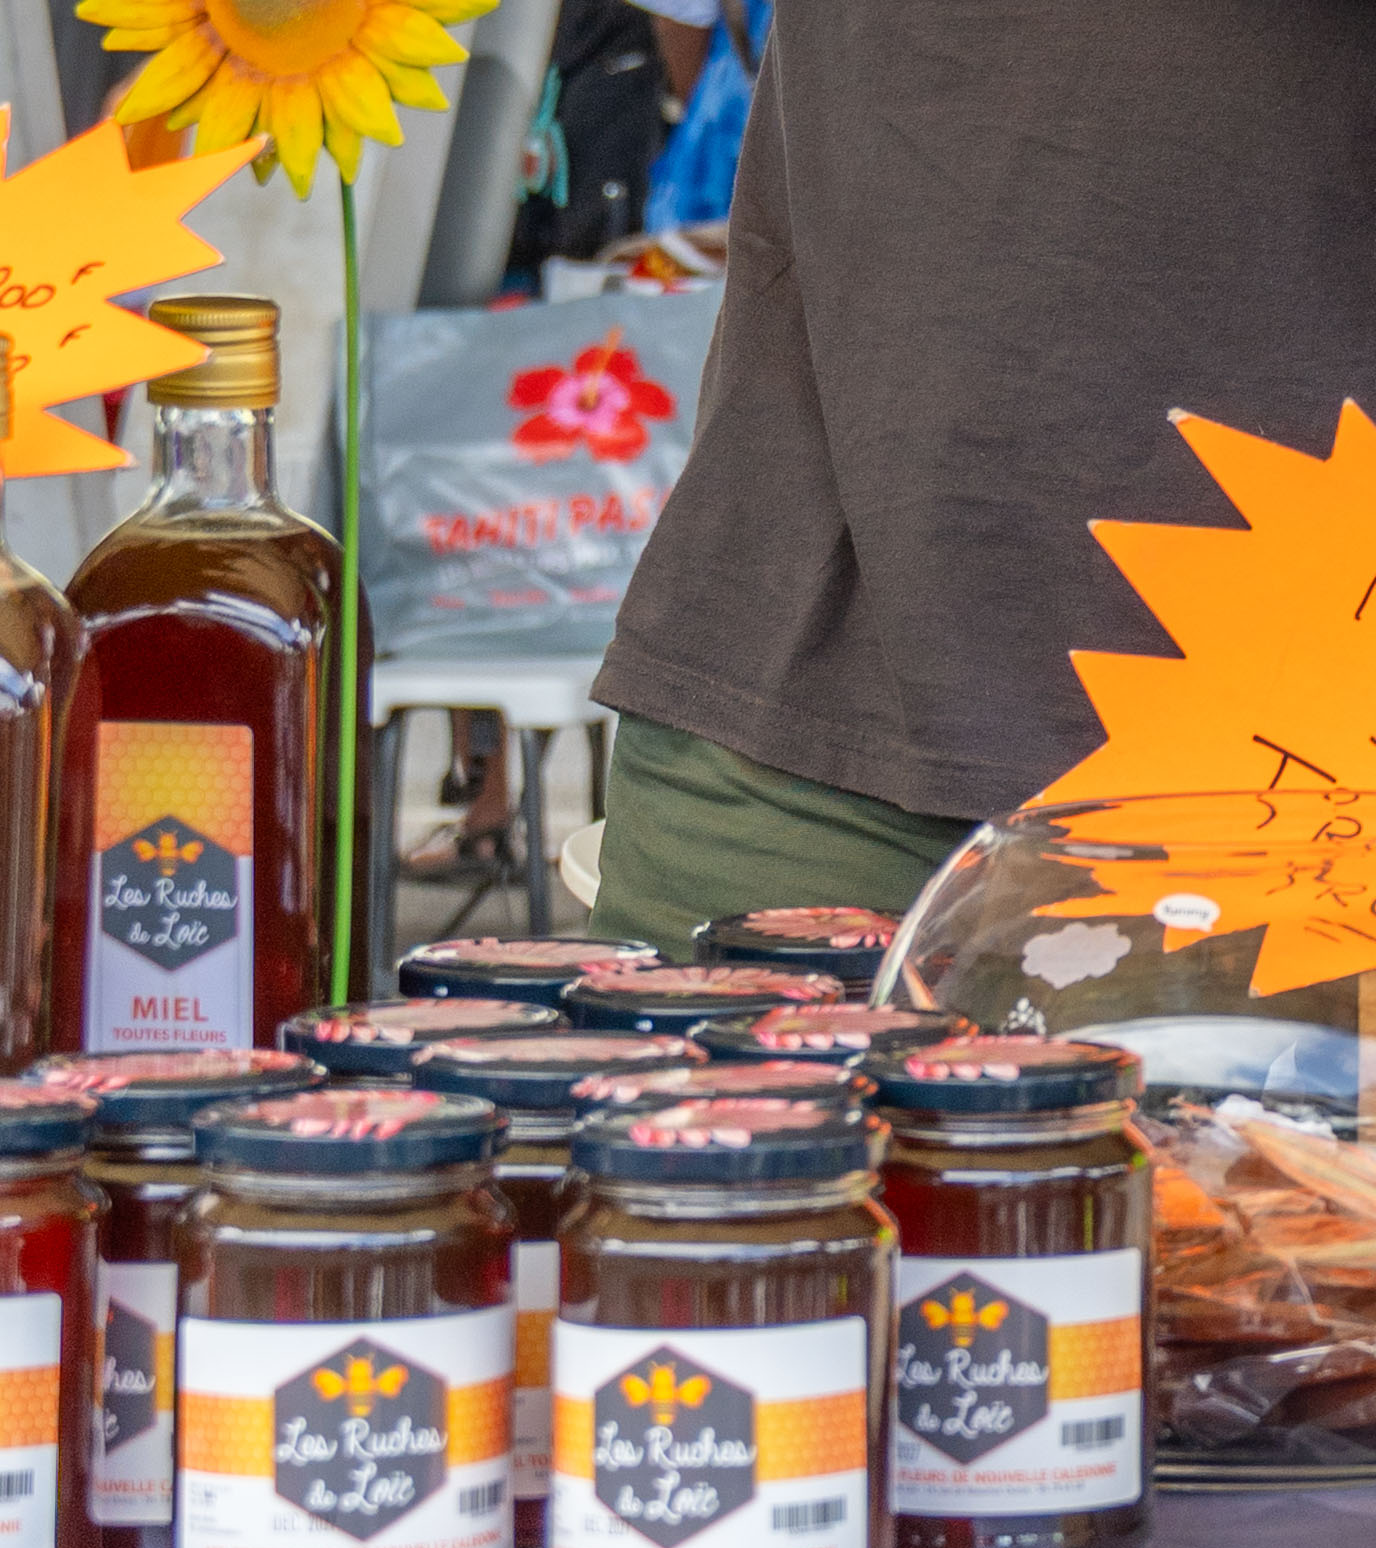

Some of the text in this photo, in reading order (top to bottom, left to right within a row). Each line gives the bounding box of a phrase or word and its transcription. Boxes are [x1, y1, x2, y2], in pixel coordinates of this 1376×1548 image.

[105, 874, 238, 910] Les Ruches
[129, 911, 210, 951] de Loïc
[132, 995, 209, 1022] MIEL
[113, 1027, 227, 1043] TOUTES FLEURS
[276, 1414, 449, 1467] Les Ruches
